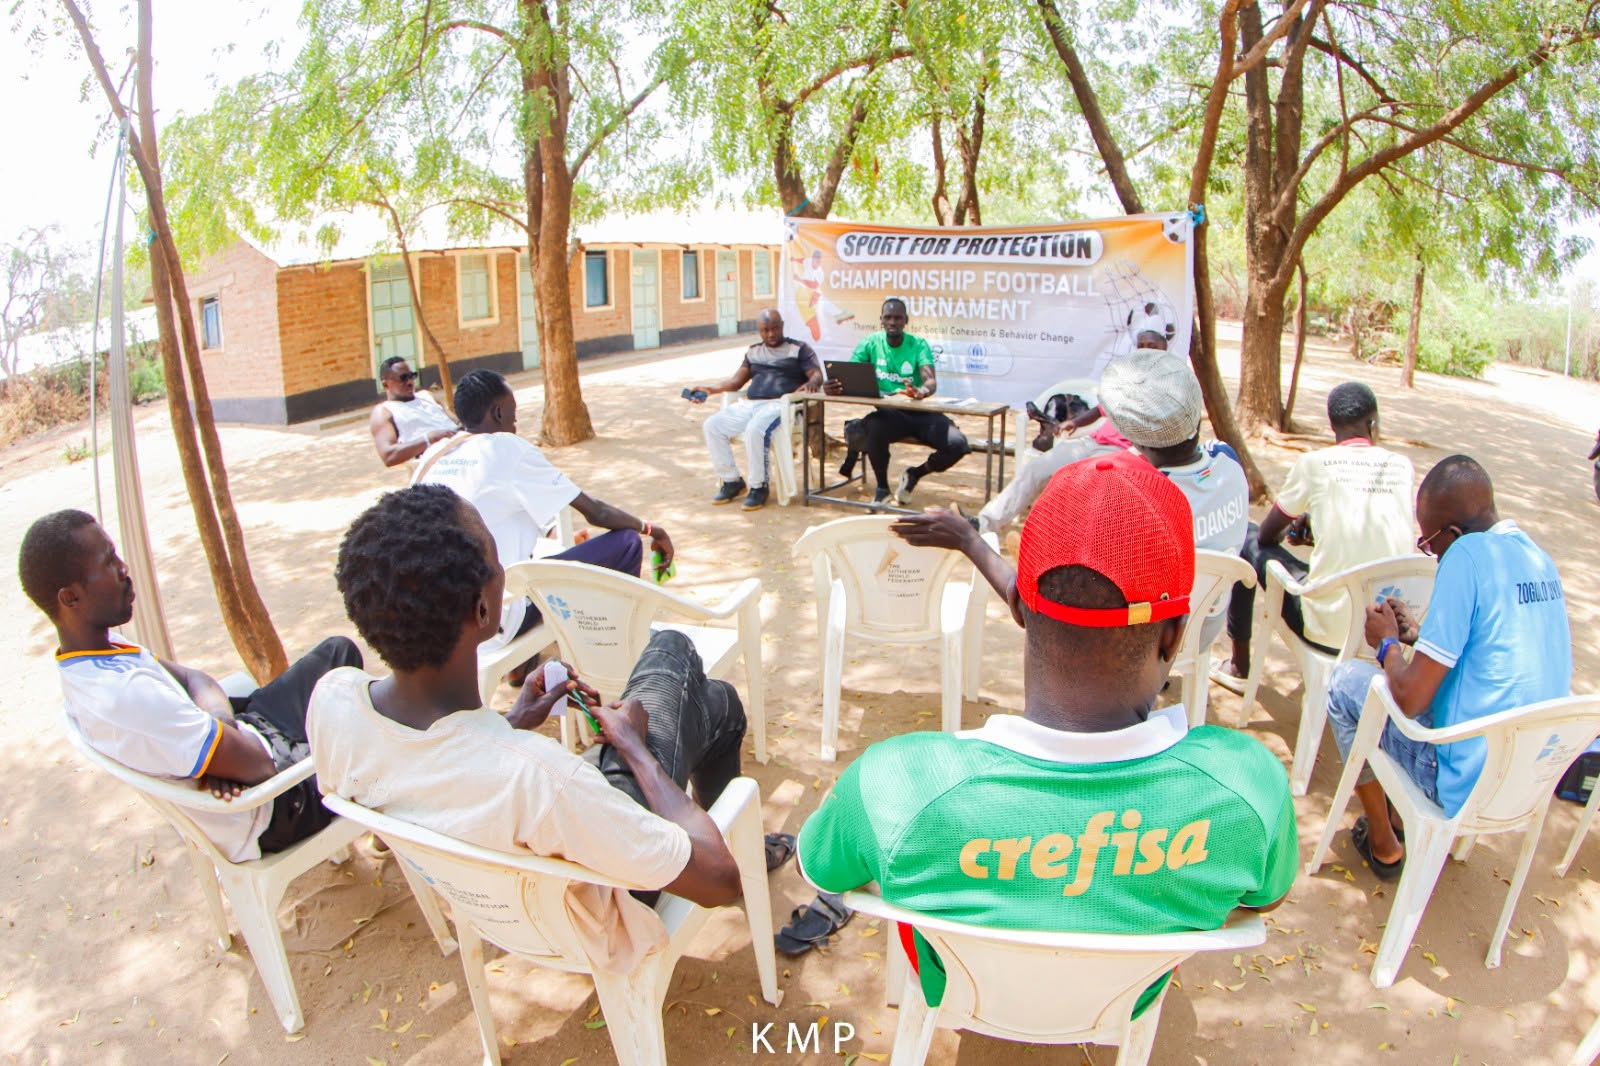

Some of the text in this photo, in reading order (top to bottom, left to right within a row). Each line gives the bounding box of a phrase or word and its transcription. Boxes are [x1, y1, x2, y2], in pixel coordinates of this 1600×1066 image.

[843, 232, 1093, 259] SPORT FOR PROTECTION
[829, 270, 1101, 297] CHAMPIONSHIP FOOTBALL
[950, 326, 988, 337] Cohesion
[990, 329, 996, 337] &
[999, 329, 1038, 340] Behavior
[1040, 332, 1075, 344] Change
[958, 808, 1211, 897] crefisa
